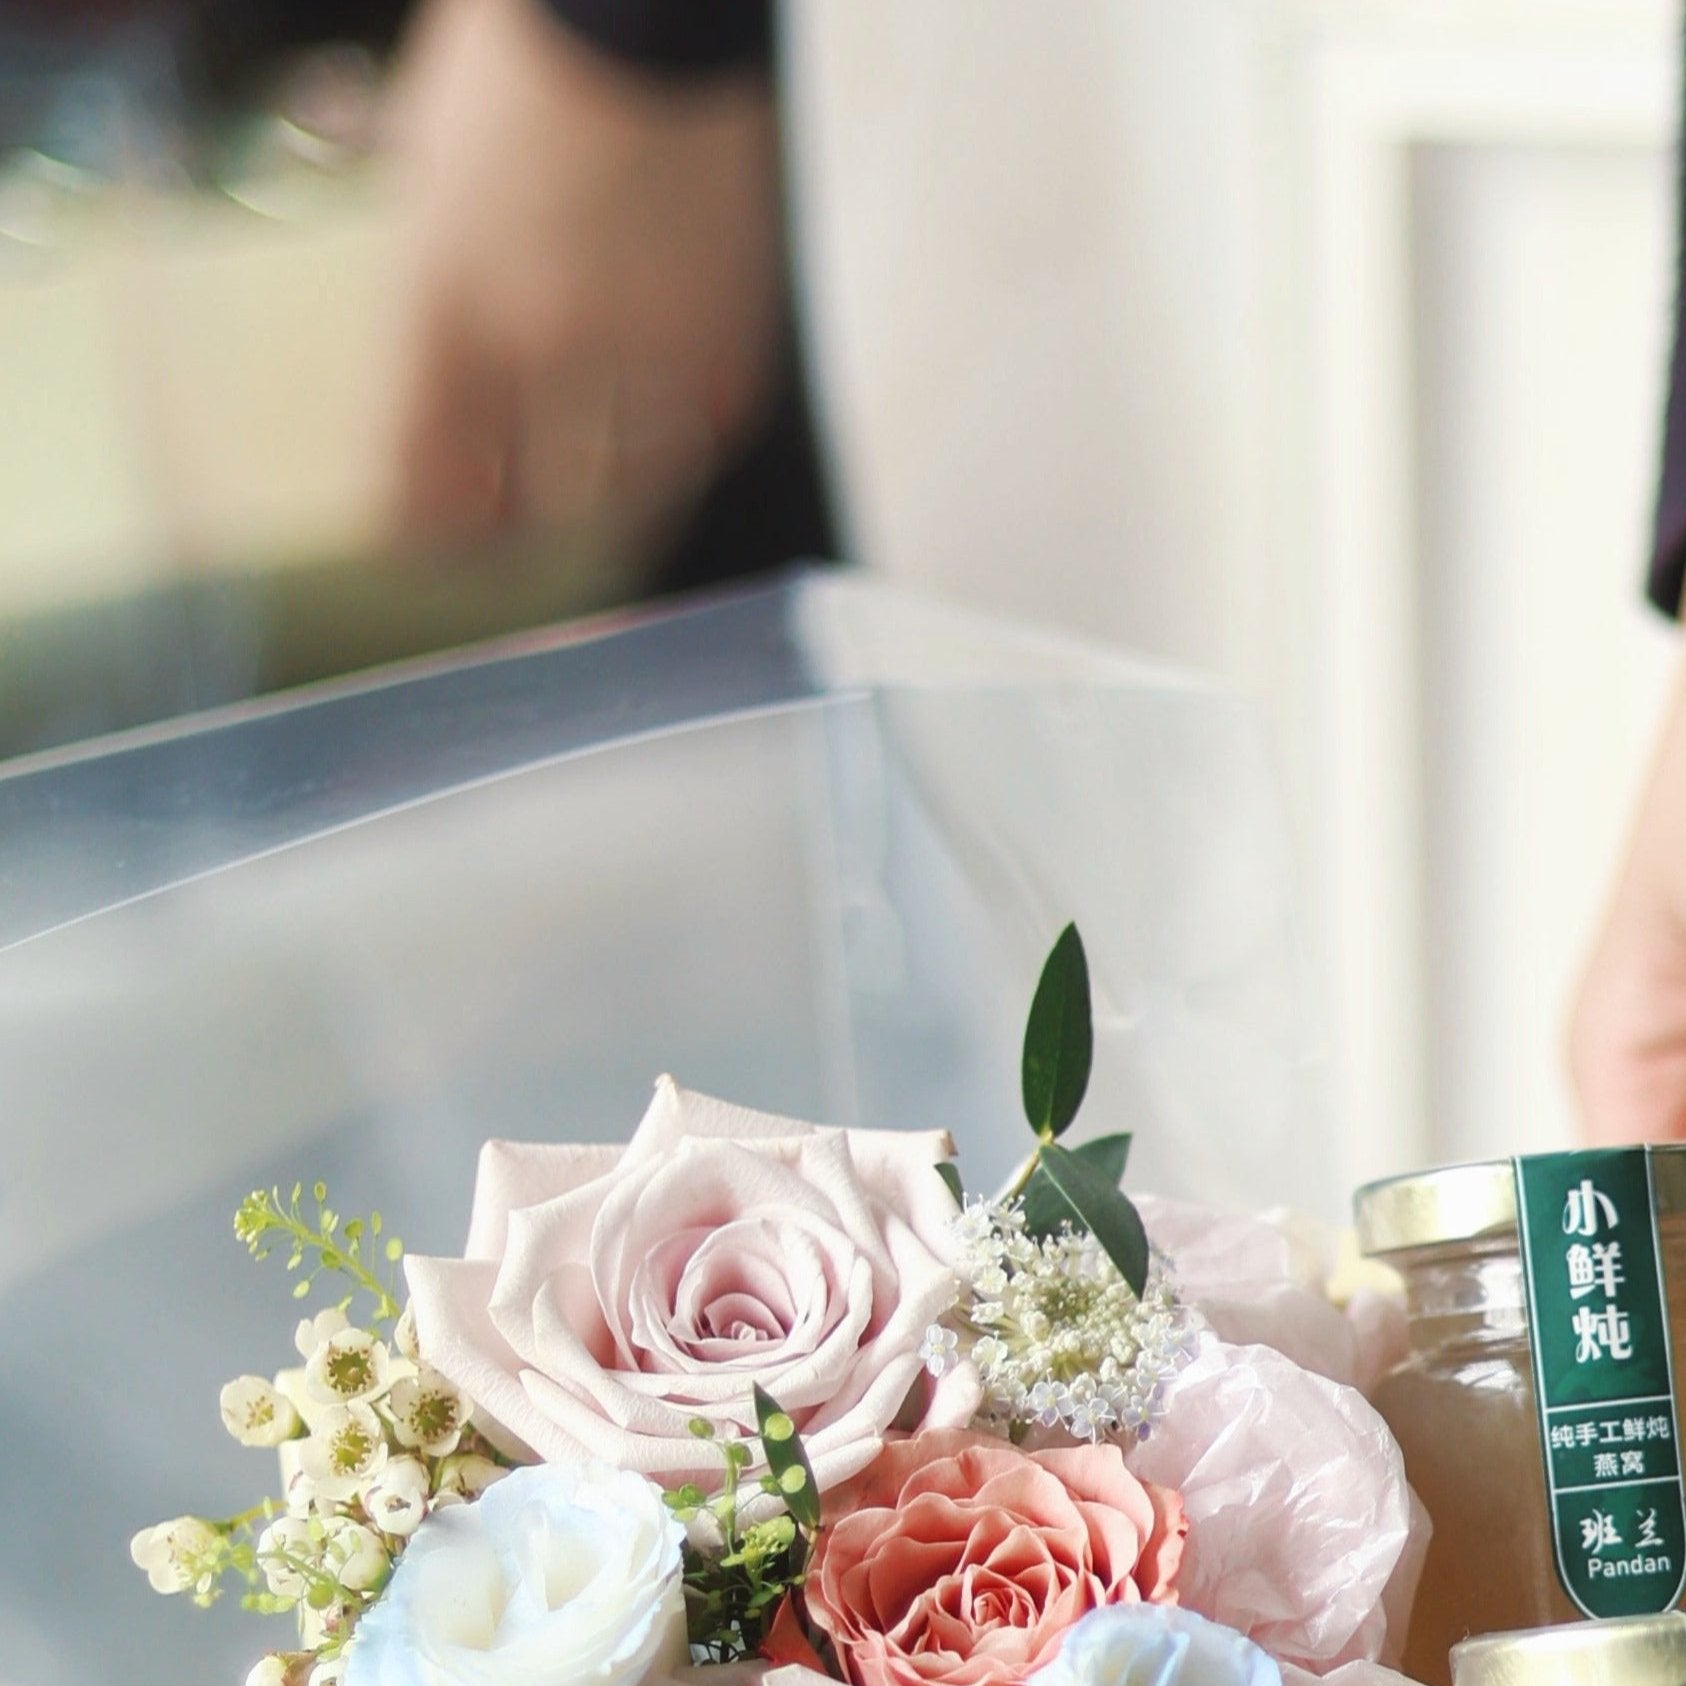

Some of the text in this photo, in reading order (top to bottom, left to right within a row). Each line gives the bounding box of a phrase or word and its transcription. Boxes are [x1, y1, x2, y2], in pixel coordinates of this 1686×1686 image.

[1562, 1180, 1632, 1363] 小鲜炖
[1551, 1416, 1670, 1449] 纯手工鲜炖
[1593, 1451, 1645, 1478] 燕窝
[1588, 1555, 1671, 1578] Pandan
